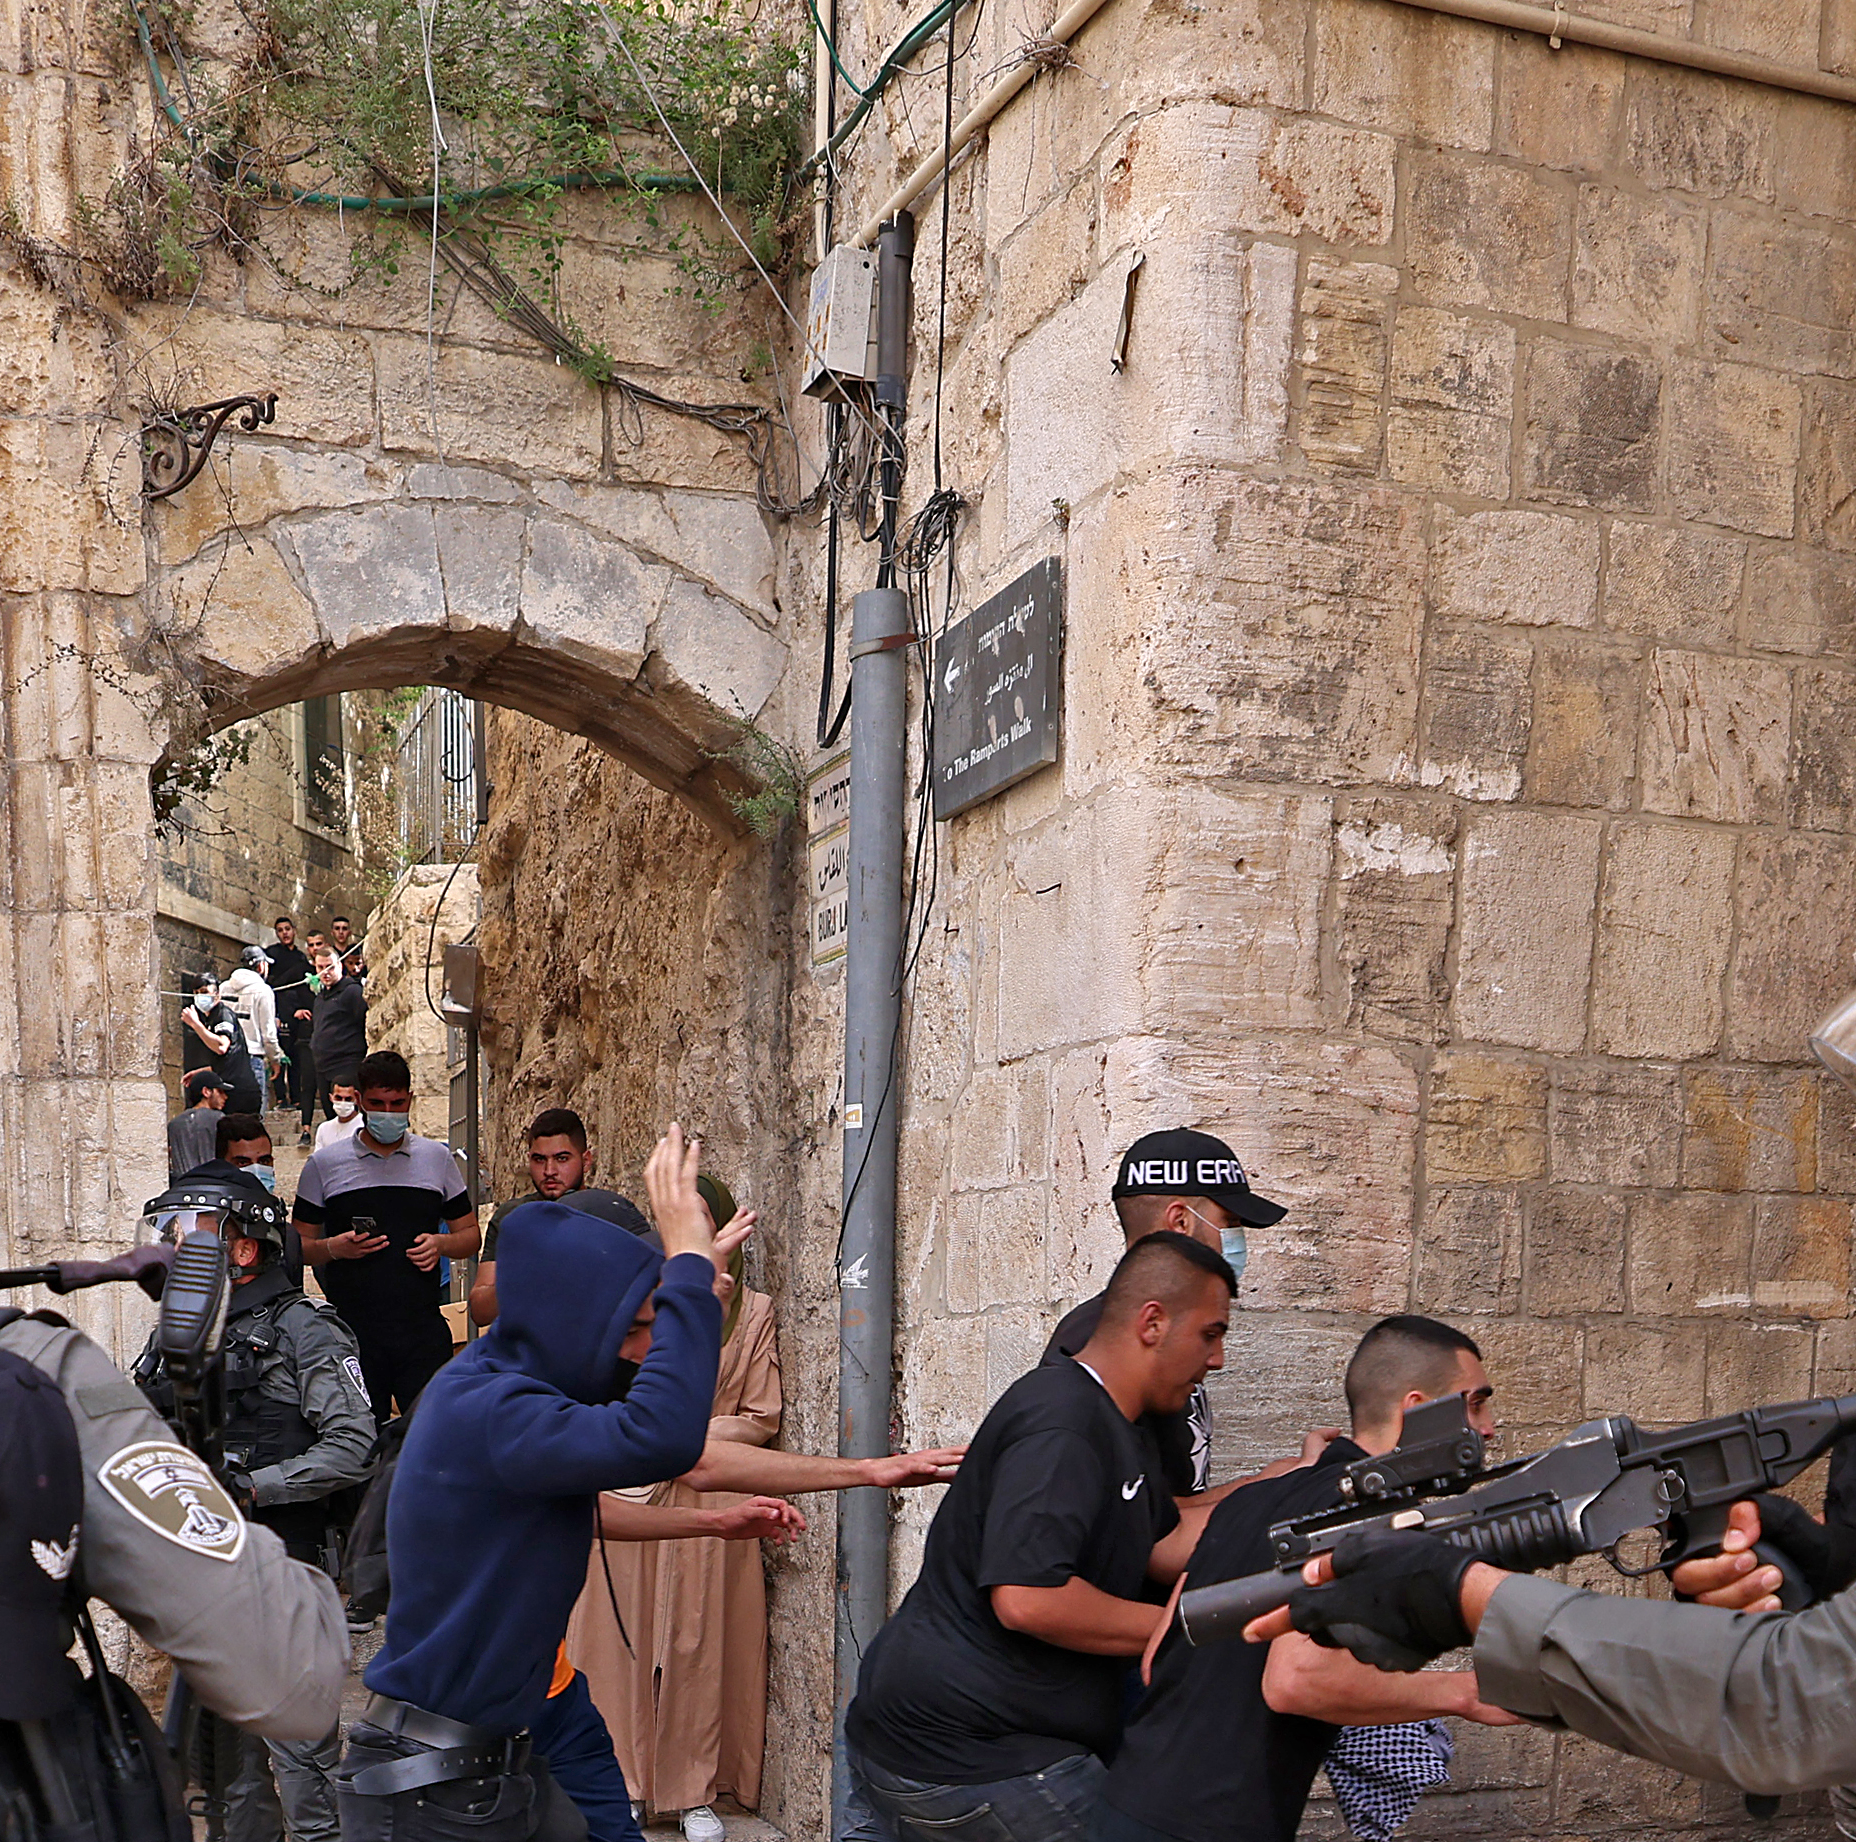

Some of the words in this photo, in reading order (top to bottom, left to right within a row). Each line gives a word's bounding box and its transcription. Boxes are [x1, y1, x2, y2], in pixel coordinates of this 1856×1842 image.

[954, 757, 969, 777] The
[1010, 716, 1032, 743] Walk
[818, 905, 836, 942] BURJ
[1127, 1160, 1188, 1186] NEW
[1197, 1160, 1246, 1185] ERA
[110, 1452, 157, 1481] ישראל
